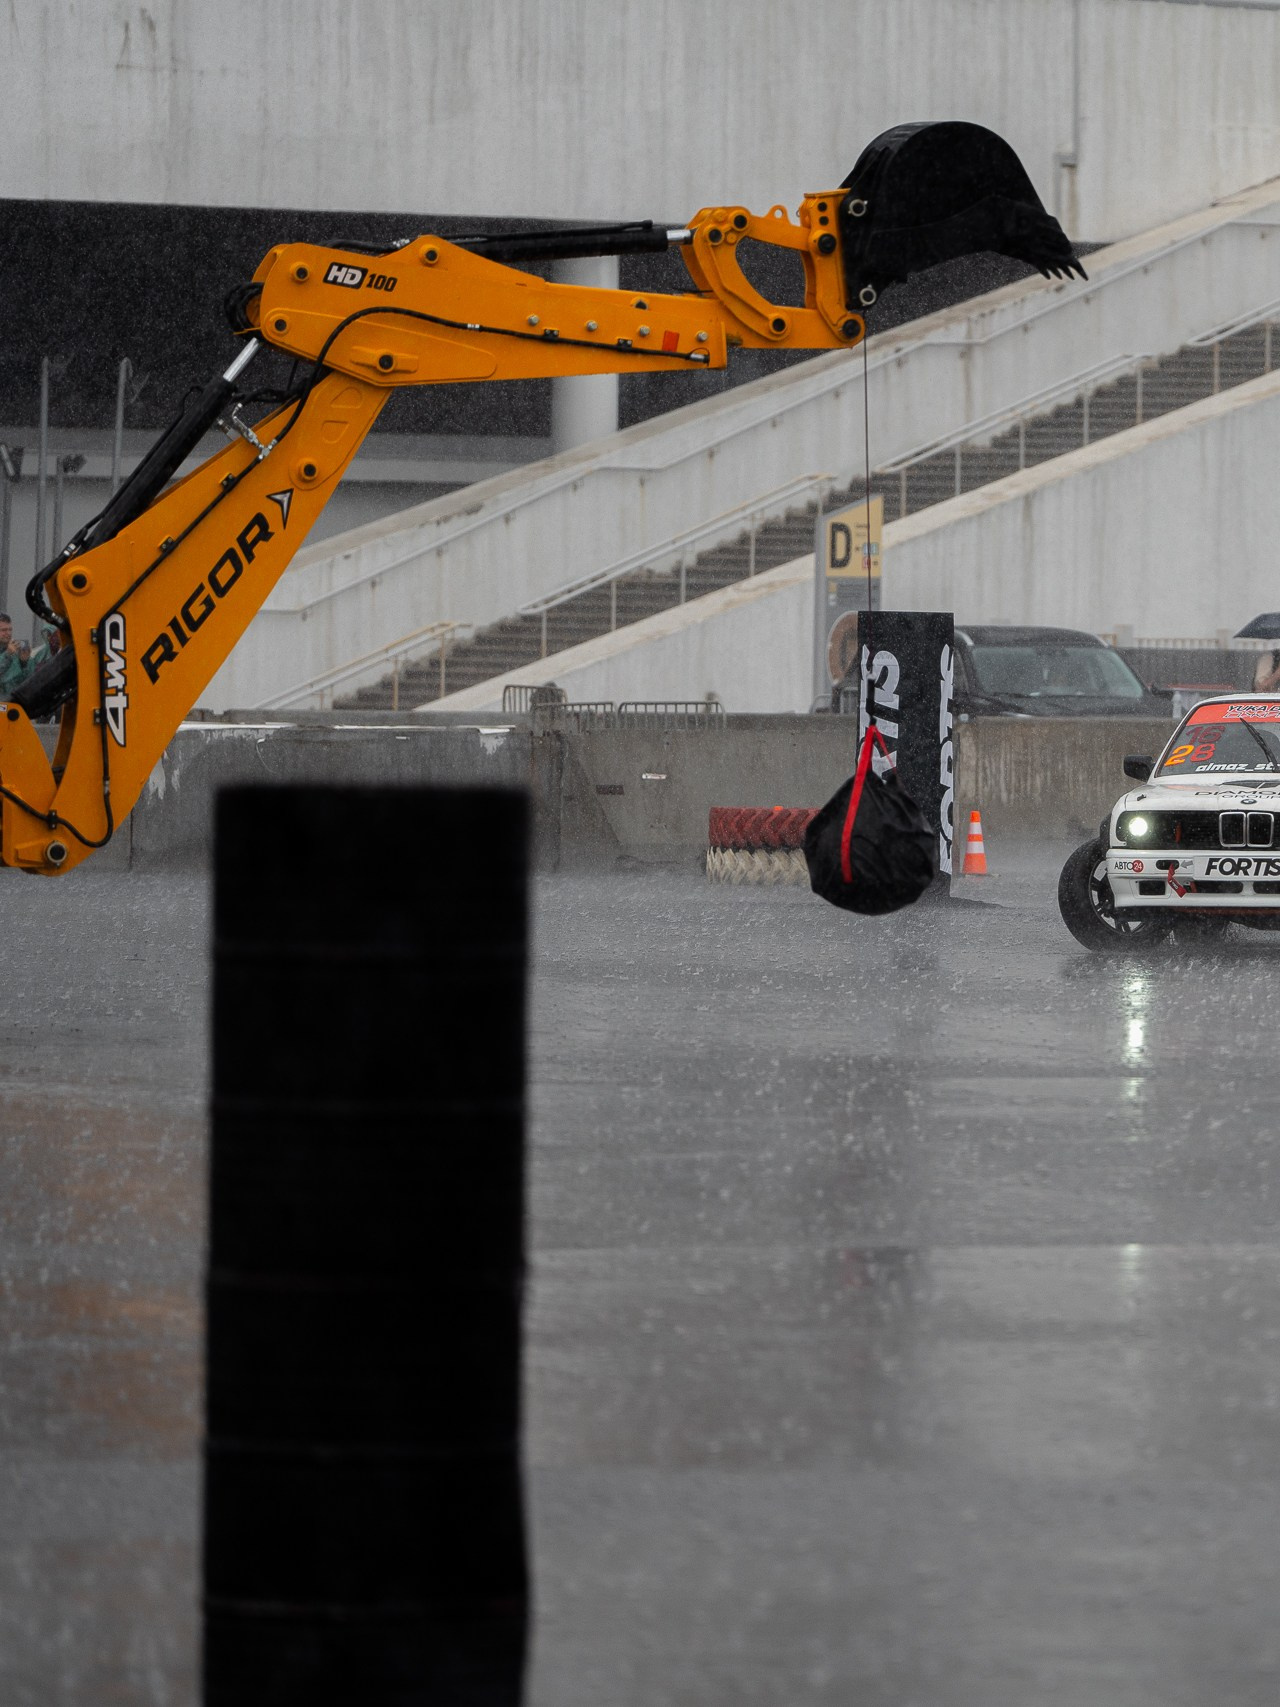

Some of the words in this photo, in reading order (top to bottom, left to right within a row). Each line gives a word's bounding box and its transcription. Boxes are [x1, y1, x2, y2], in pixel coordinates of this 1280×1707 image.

[326, 265, 363, 285] HD
[366, 273, 398, 292] 100
[830, 522, 852, 568] D
[140, 512, 275, 685] RIGOR
[104, 611, 129, 747] 4WD
[1186, 725, 1225, 744] 16
[1164, 743, 1216, 766] 28
